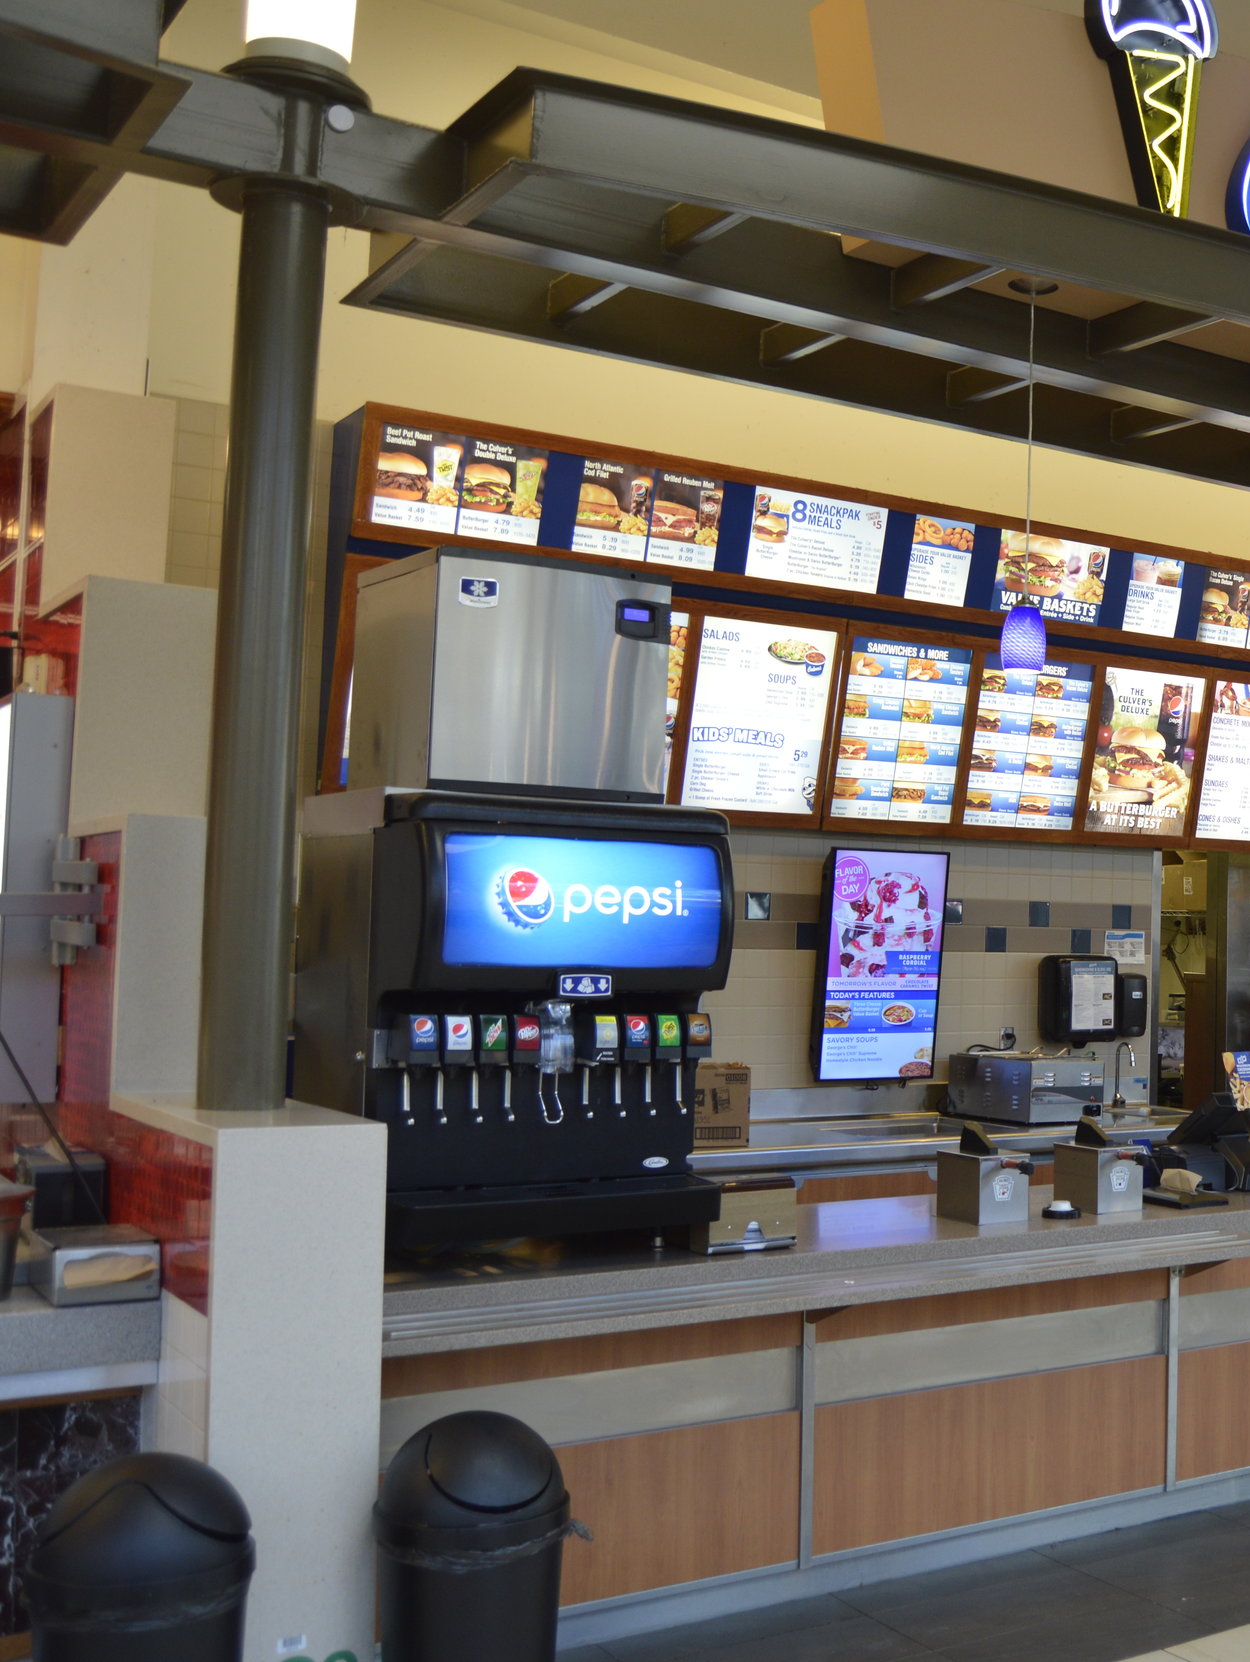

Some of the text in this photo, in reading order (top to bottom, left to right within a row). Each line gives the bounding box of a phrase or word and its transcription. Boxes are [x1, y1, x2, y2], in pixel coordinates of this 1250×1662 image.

[386, 427, 433, 441] Beef Pot Roast
[386, 435, 417, 447] Sandwich
[475, 441, 514, 454] The Culver's
[474, 450, 517, 463] Double Deluxe
[584, 461, 624, 474] North Atlantic
[584, 468, 610, 479] Cod Filet
[664, 474, 715, 489] Grilled Reuben Melt
[791, 500, 861, 523] 8 SNACKPAK
[807, 514, 842, 530] MEALS
[910, 552, 934, 565] SIDES
[1128, 588, 1154, 600] DRINKS
[1042, 597, 1096, 617] BASKETS
[703, 628, 740, 642] SALADS
[867, 642, 949, 660] SANDWICHES & MORE
[767, 673, 797, 685] SOUPS
[1130, 687, 1145, 697] THE
[1118, 695, 1153, 707] CULVER'S
[1120, 705, 1150, 716] DELUXE
[1213, 716, 1240, 727] CONCRETE
[692, 726, 785, 748] KIDS' MEALS
[1208, 754, 1229, 764] SHAKES
[1204, 779, 1228, 788] SUNDAES
[1089, 802, 1178, 819] A BUTTERBURGER
[1104, 814, 1163, 830] AT ITS BEST
[1198, 814, 1216, 823] CONES
[1222, 816, 1241, 824] DISHES
[835, 865, 864, 877] FLAVOR
[841, 884, 860, 895] DAY
[563, 880, 683, 924] pepsi
